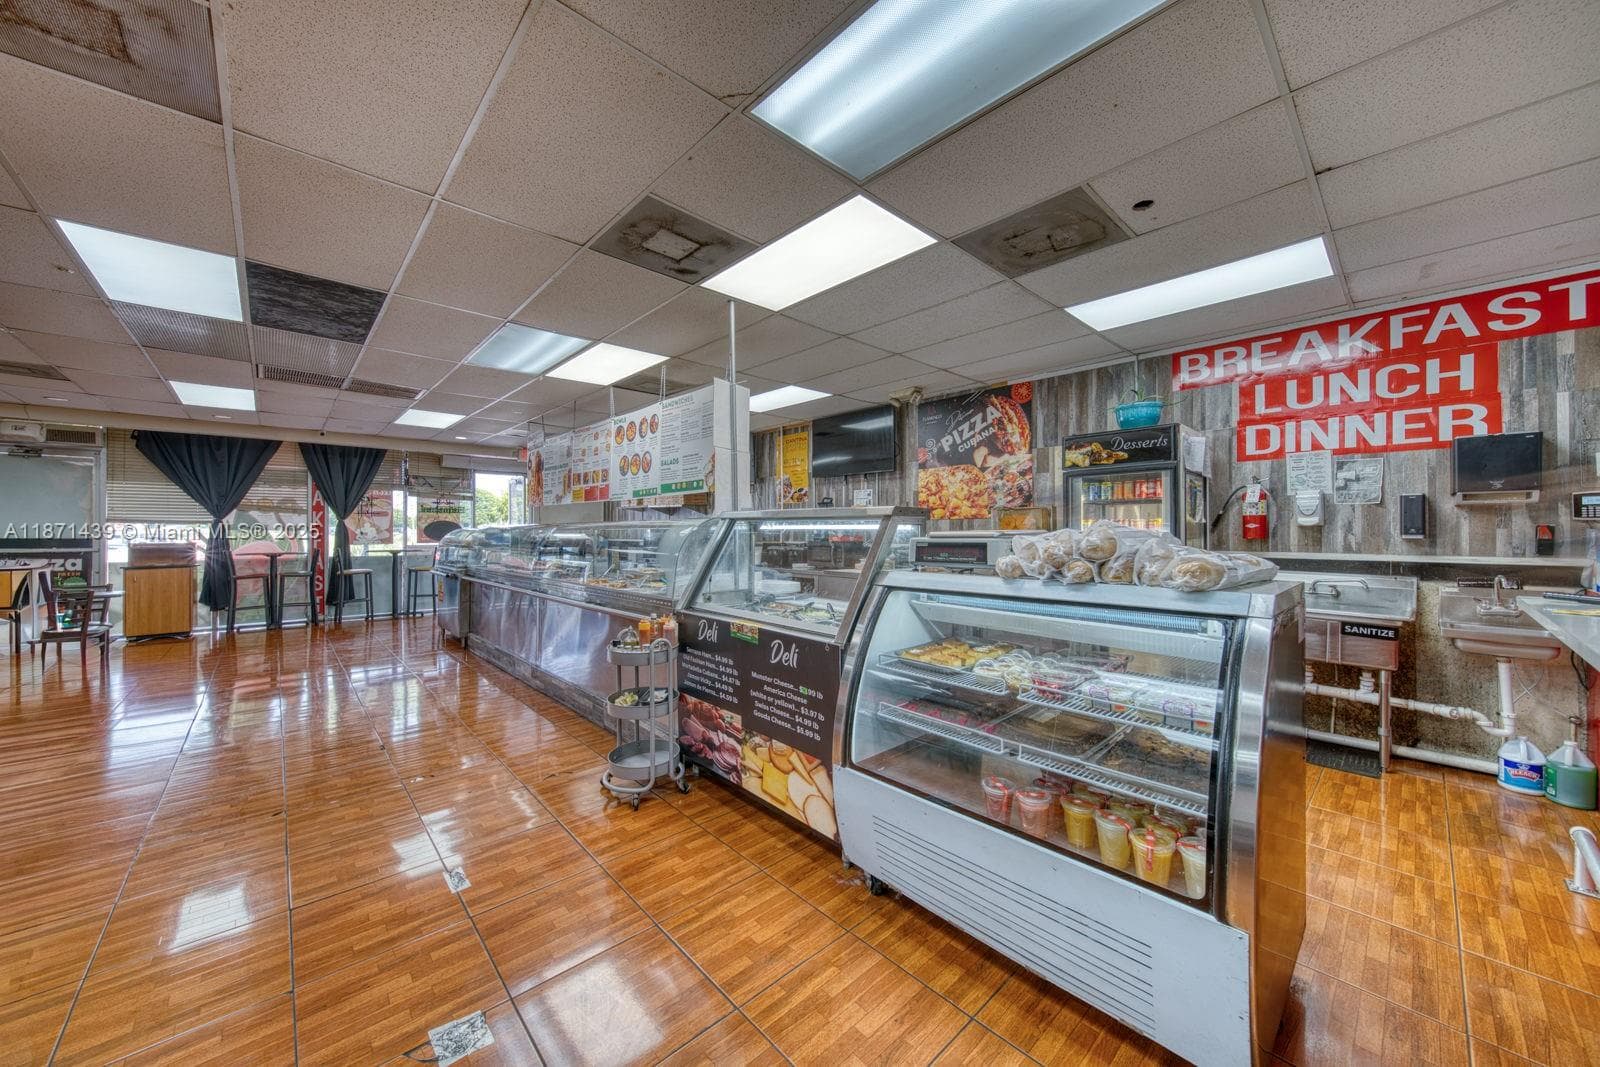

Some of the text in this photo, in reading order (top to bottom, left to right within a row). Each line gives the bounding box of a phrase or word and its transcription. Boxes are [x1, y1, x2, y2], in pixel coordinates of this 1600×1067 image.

[1179, 276, 1600, 384] BREAKFAST
[1254, 353, 1475, 415] LUNCH
[940, 404, 1003, 452] PIZZA
[958, 427, 995, 452] CUBANA
[1245, 403, 1488, 456] DINNER
[1110, 434, 1168, 451] Desserts
[698, 619, 719, 643] Deli
[1344, 625, 1395, 638] SANITIZE
[769, 639, 800, 669] Deli
[764, 684, 808, 705] America Cheese
[753, 709, 771, 722] Gouda
[814, 732, 821, 742] lb
[812, 721, 819, 730] lb
[818, 712, 825, 722] lb
